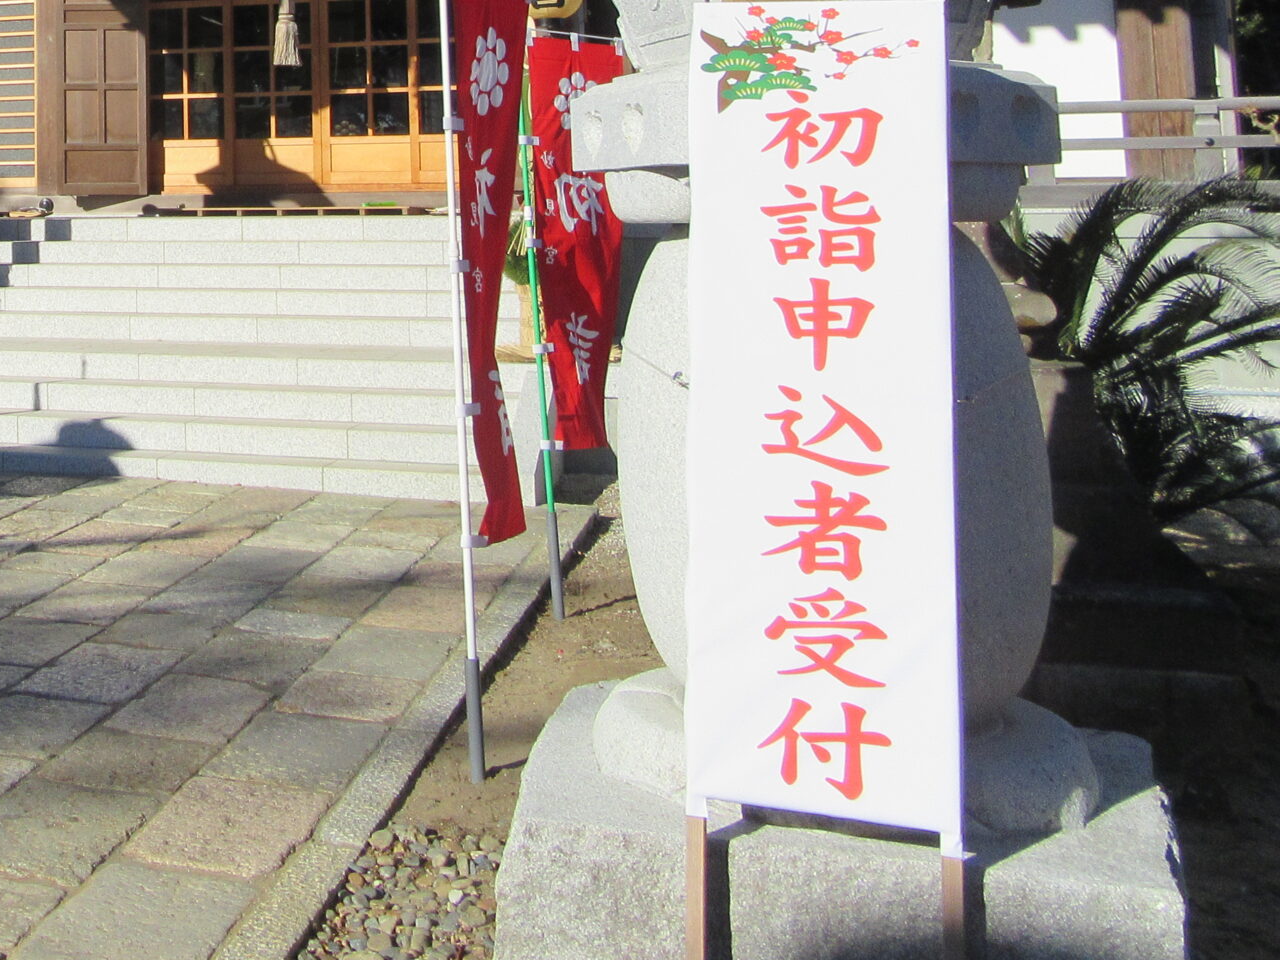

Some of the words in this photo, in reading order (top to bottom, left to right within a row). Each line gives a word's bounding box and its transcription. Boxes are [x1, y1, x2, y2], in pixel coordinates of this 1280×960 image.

[757, 90, 892, 800] 初詣申込者受付
